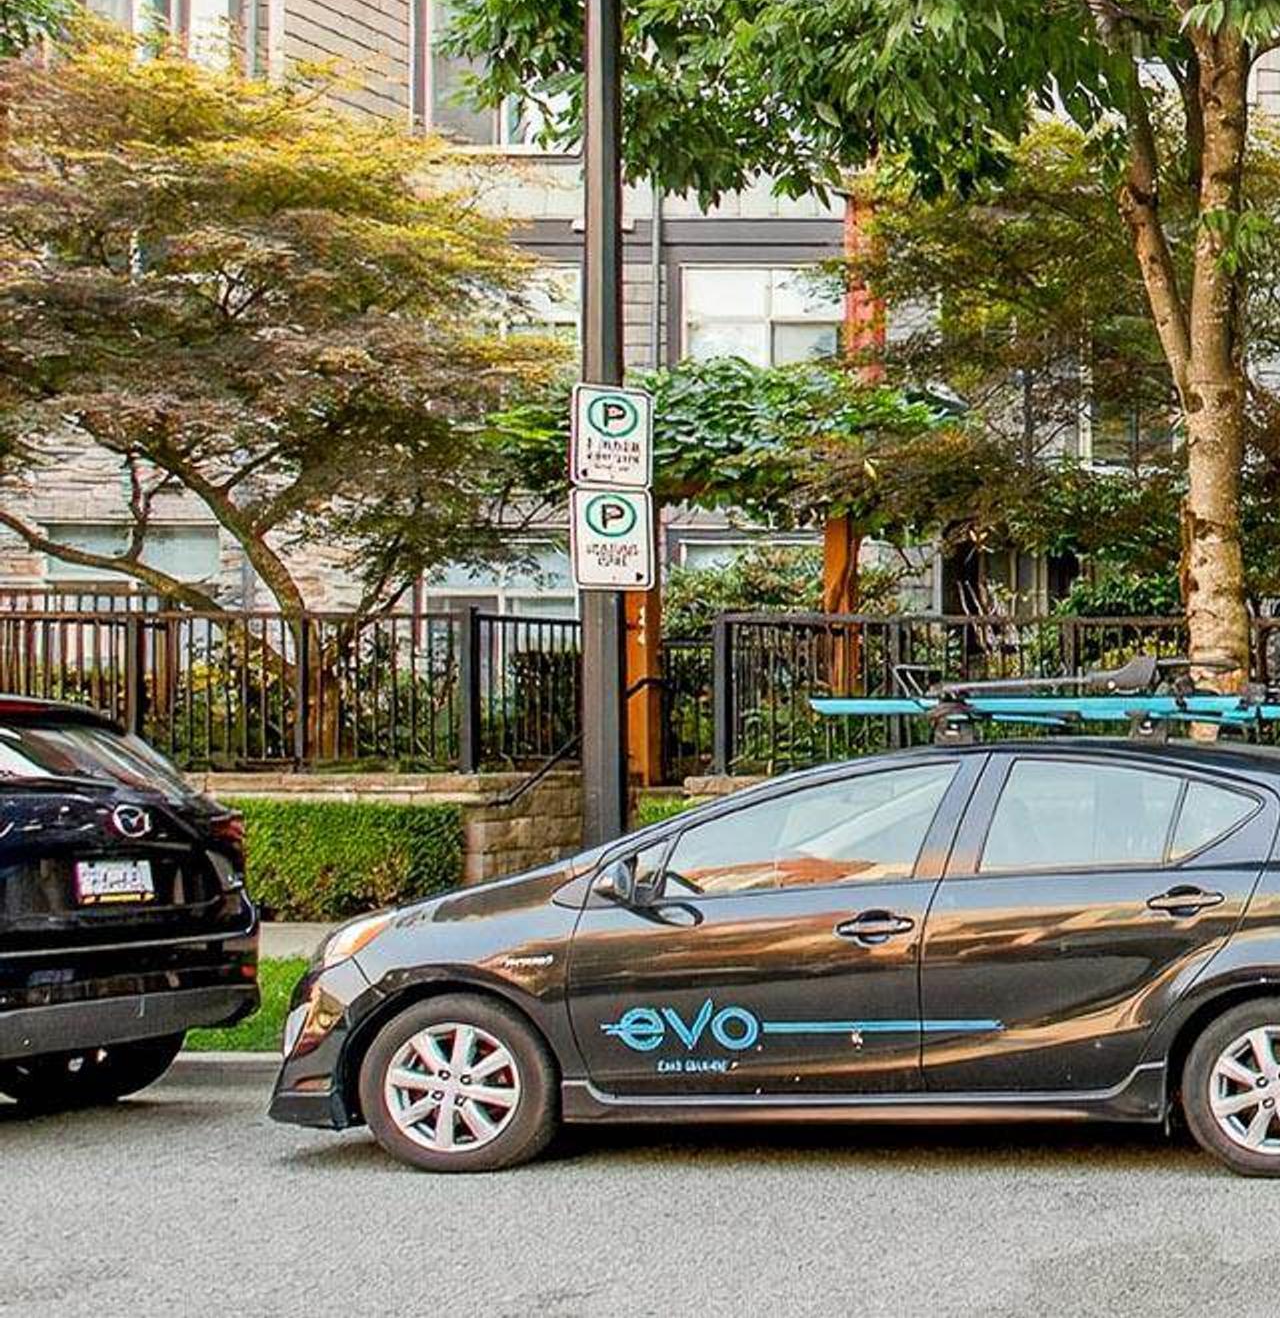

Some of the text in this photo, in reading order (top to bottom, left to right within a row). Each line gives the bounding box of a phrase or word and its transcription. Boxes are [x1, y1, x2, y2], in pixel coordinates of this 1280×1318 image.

[602, 401, 627, 429] P
[601, 502, 626, 530] P
[601, 998, 760, 1051] evo
